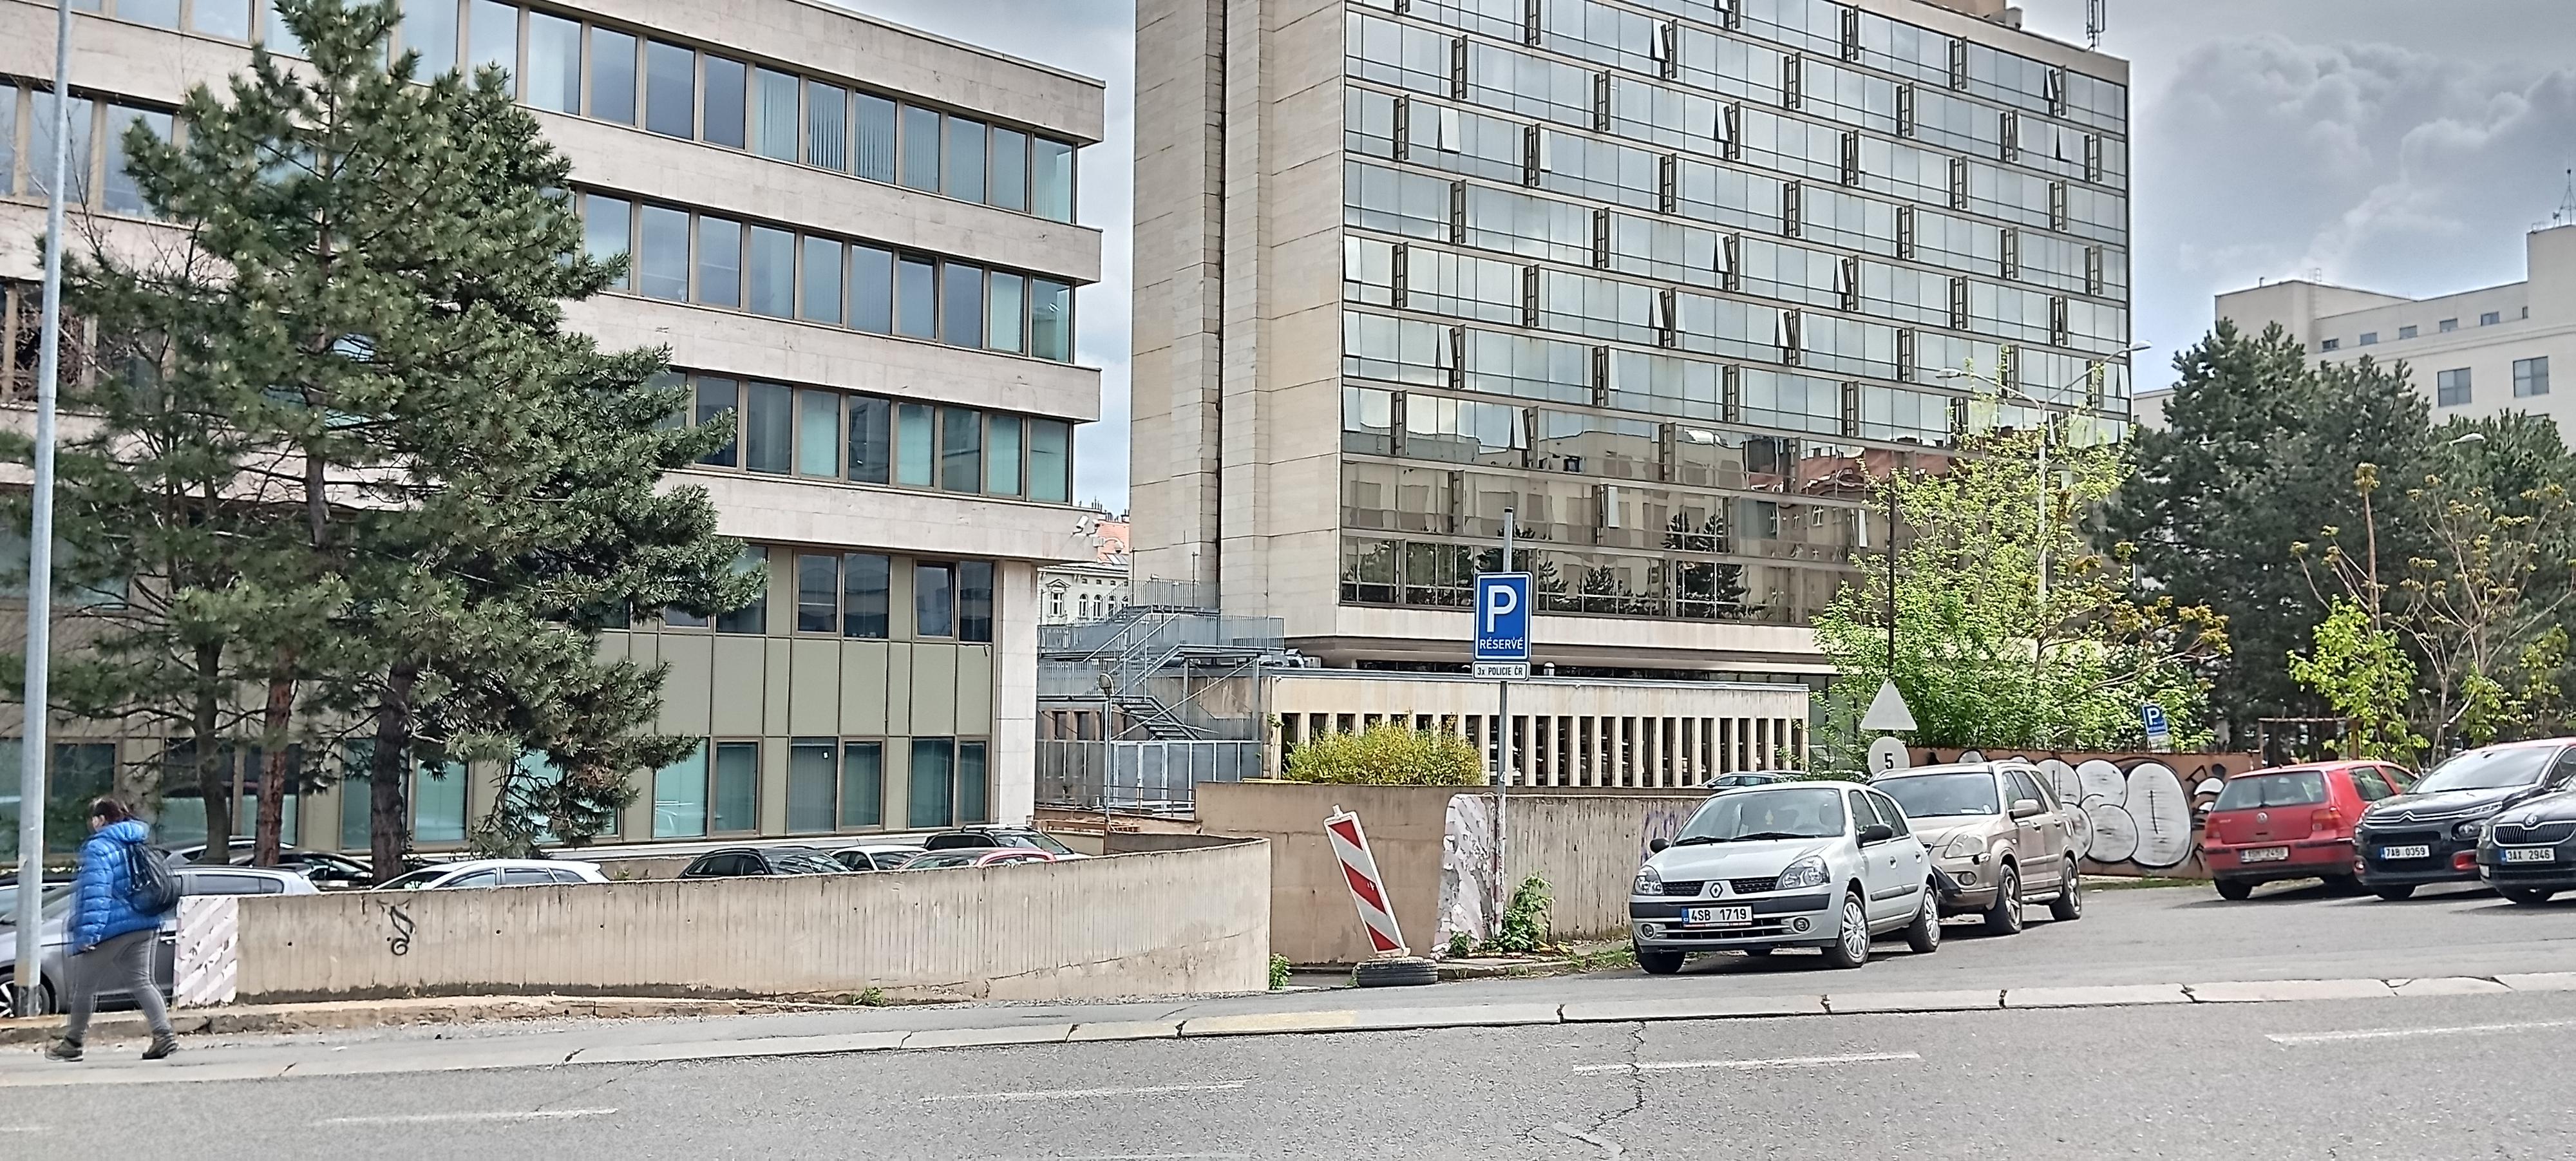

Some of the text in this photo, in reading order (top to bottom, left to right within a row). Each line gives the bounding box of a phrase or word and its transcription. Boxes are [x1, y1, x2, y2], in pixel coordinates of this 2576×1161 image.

[1487, 585, 1517, 632] P
[1488, 667, 1511, 675] POLICIE
[1514, 665, 1523, 675] ČR
[2146, 708, 2160, 725] P
[1884, 753, 1893, 769] 5
[2405, 847, 2425, 856] 0359
[2508, 850, 2550, 860] 3AX 2946
[1691, 909, 1747, 921] 4SB 1719
